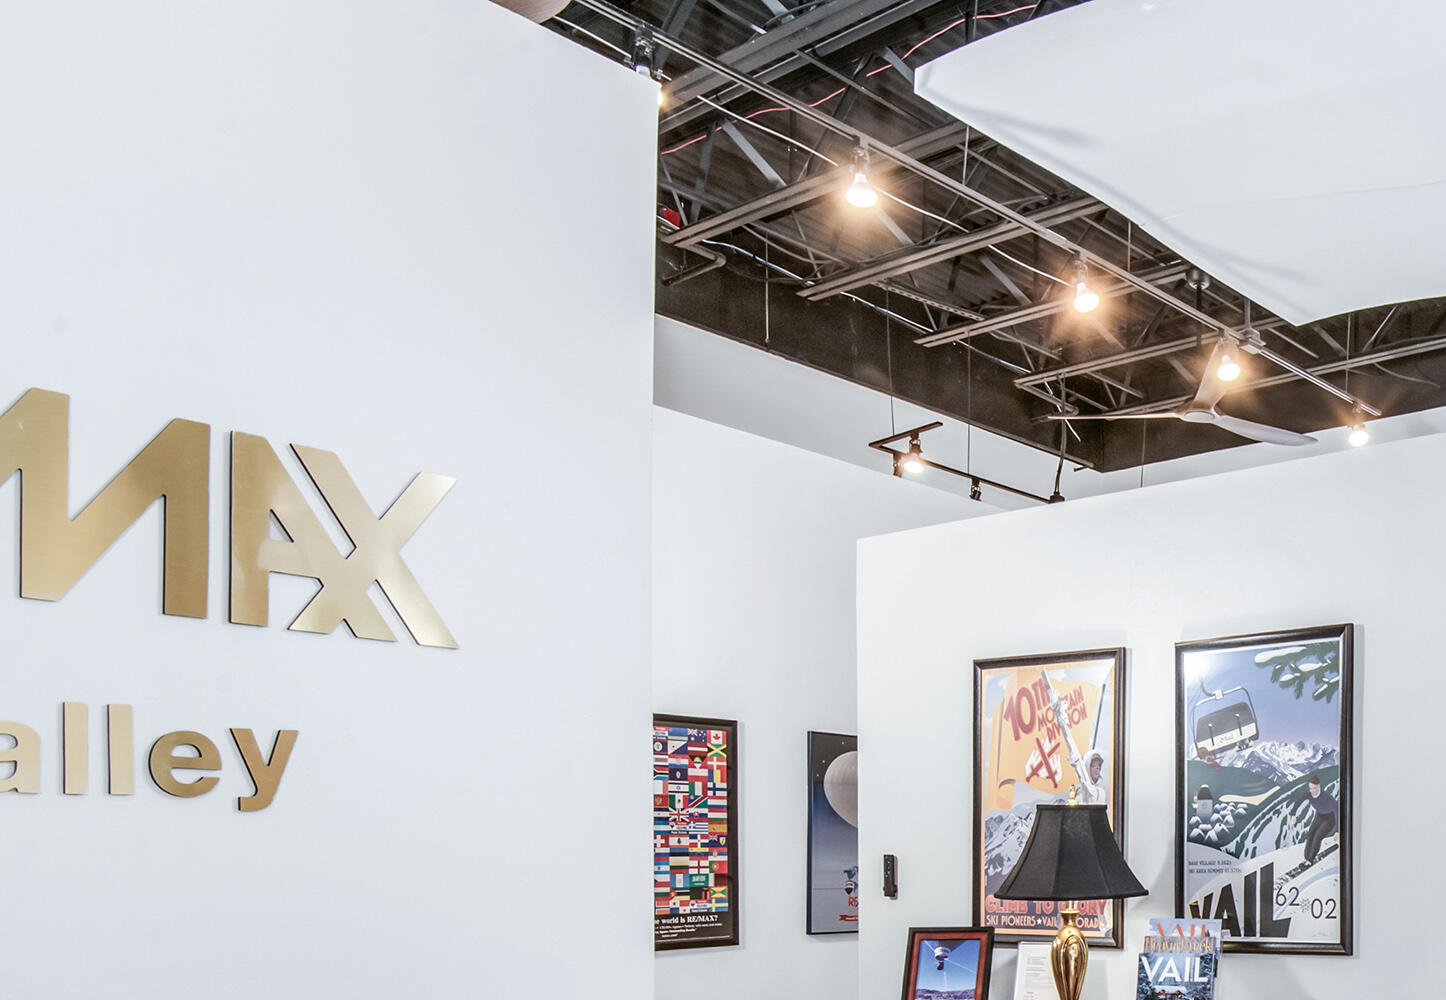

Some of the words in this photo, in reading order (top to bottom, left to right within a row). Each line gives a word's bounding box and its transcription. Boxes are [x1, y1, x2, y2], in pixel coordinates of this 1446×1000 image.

[1275, 886, 1300, 907] 62
[1310, 898, 1337, 919] 02
[986, 914, 999, 926] SKI
[1001, 914, 1036, 928] PIONEERS
[1141, 957, 1208, 982] VAIL
